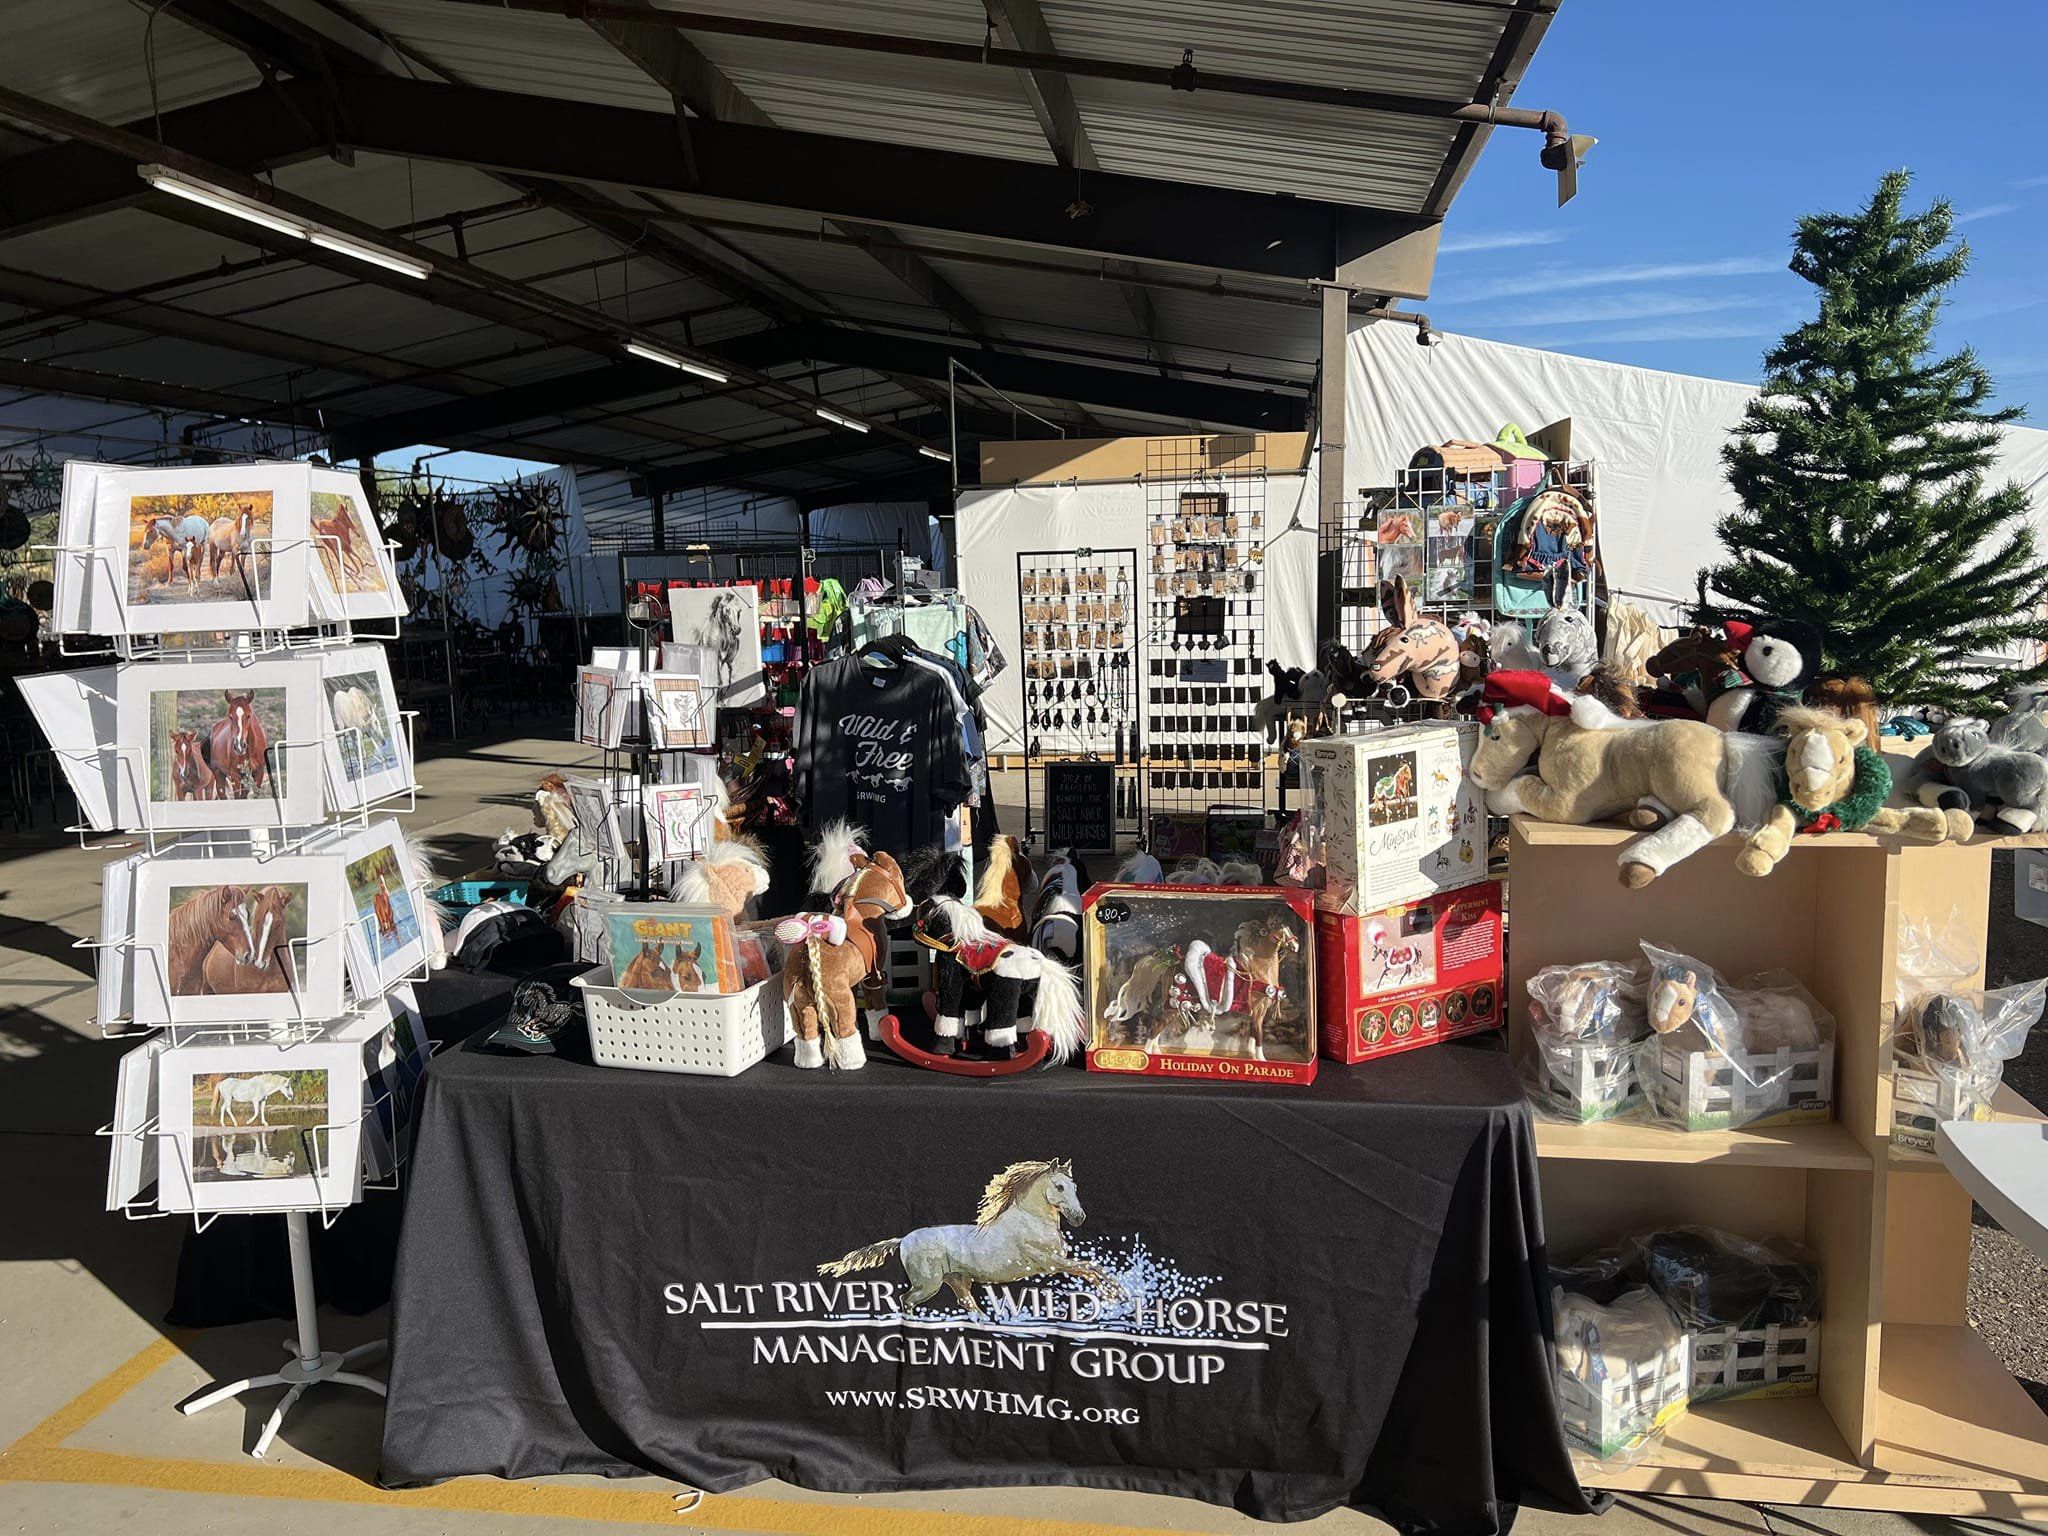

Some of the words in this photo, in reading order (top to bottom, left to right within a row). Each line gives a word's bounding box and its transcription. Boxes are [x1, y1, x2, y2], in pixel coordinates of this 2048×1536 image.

[839, 713, 899, 740] Wild
[899, 724, 917, 744] &
[855, 741, 914, 770] Free
[1369, 822, 1418, 857] Minstrel
[1099, 1052, 1145, 1068] Breyer
[1160, 1058, 1214, 1073] HOLIDAY
[1218, 1061, 1240, 1074] ON
[1244, 1062, 1295, 1078] PARADE
[1897, 1133, 1930, 1147] Breyer
[663, 1281, 764, 1314] SALT
[771, 1279, 901, 1313] RIVER
[982, 1284, 1102, 1323] WILD
[1131, 1295, 1290, 1337] HORSE
[752, 1332, 1055, 1372] MANAGEMENT
[1069, 1346, 1226, 1385] GROUP
